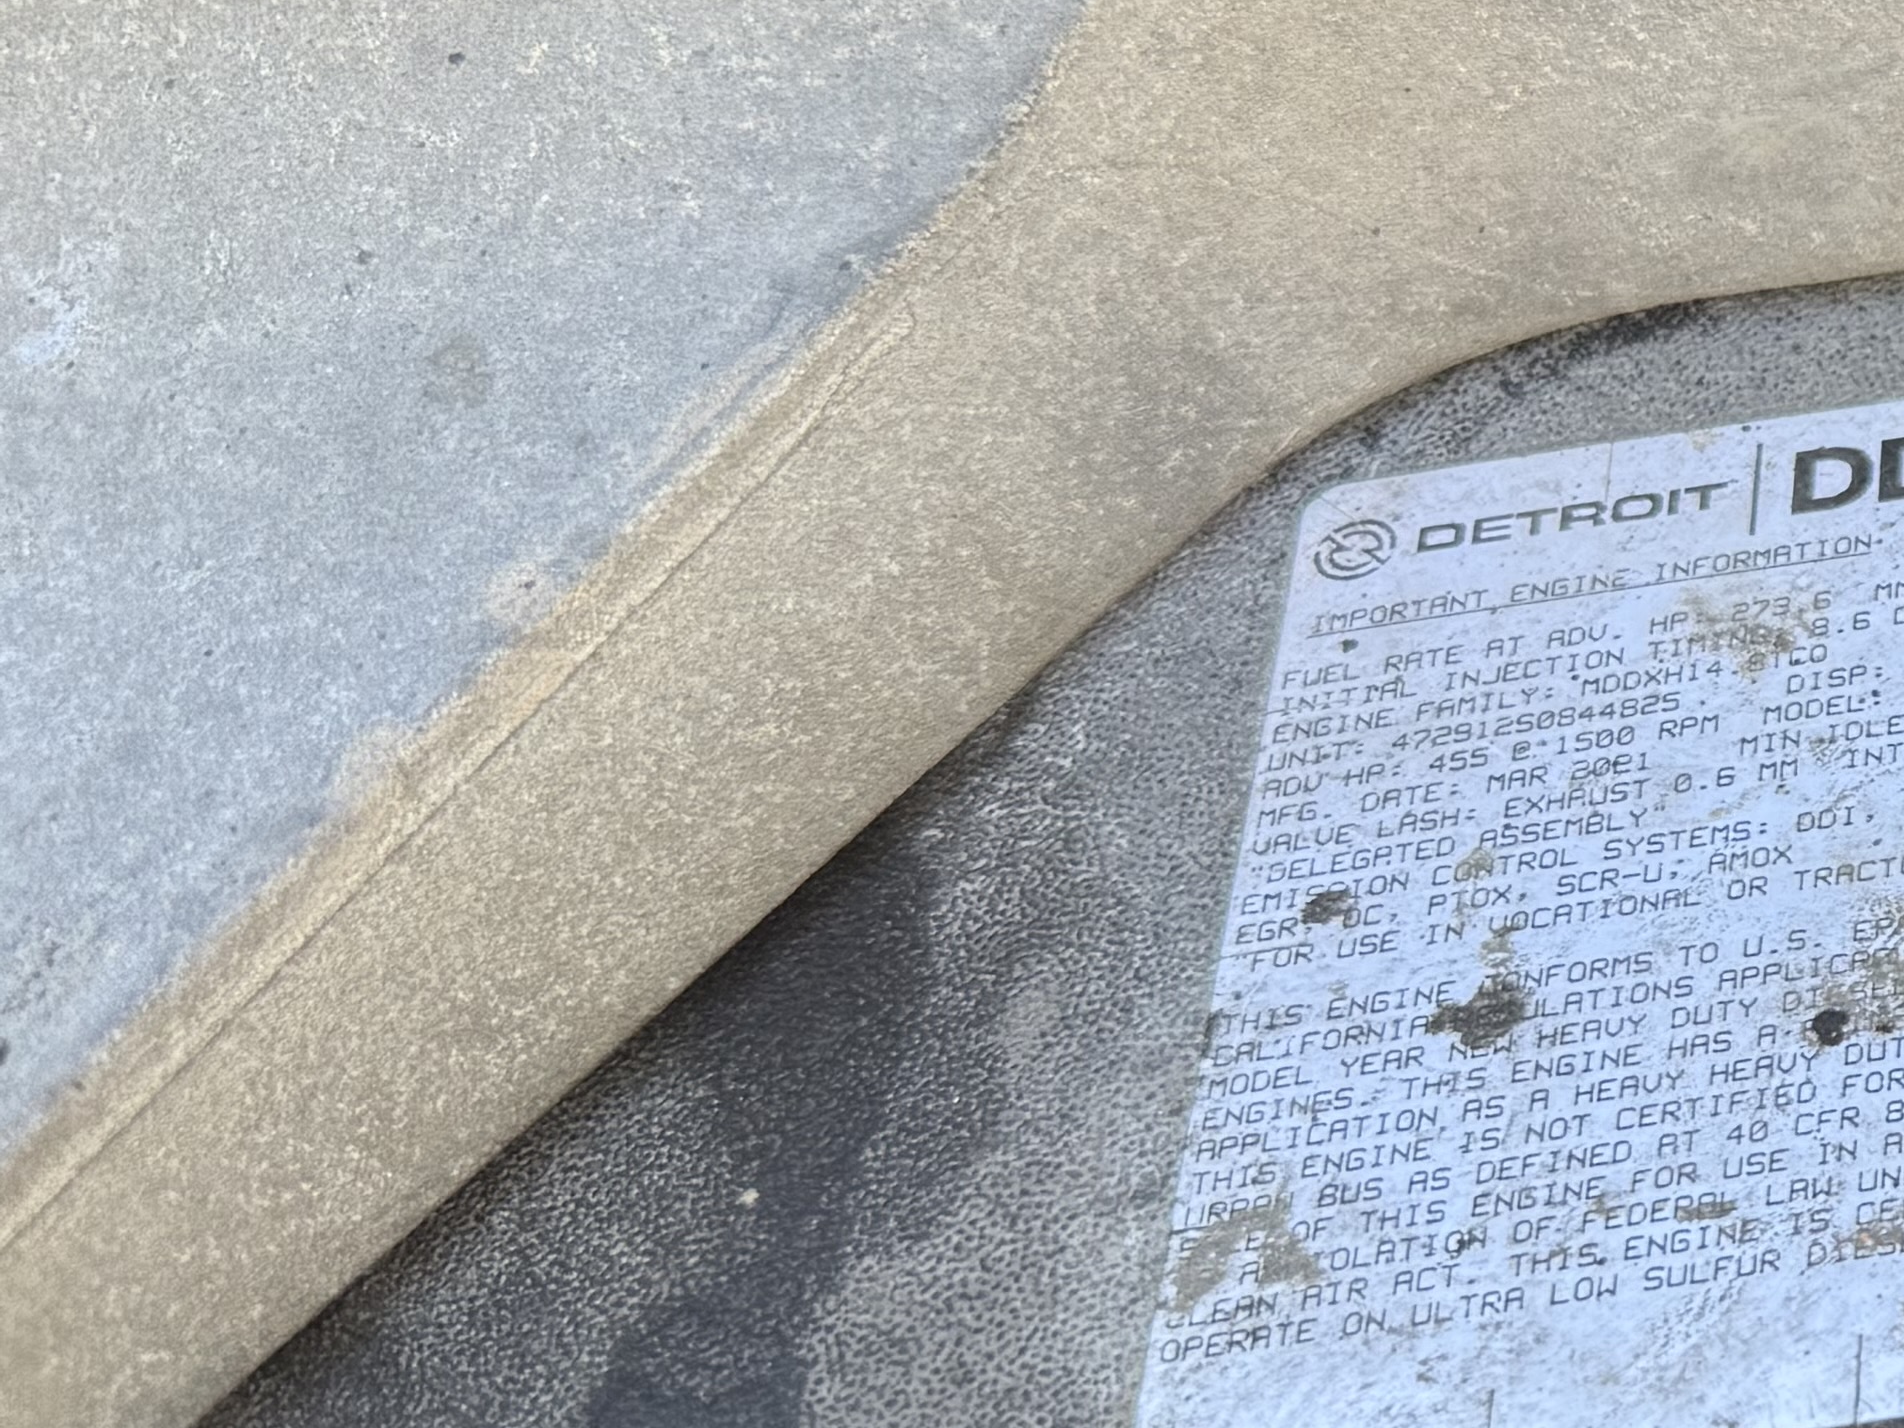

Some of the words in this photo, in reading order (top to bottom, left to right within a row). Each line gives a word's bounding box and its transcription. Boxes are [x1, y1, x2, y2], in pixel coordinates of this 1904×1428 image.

[1415, 480, 1734, 554] DETROIT
[1313, 588, 1493, 634] IMPORTANT
[1512, 567, 1634, 604] ENGINE
[1656, 532, 1875, 583] INFORMATION
[1278, 675, 1421, 715] INITIAL
[1443, 645, 1626, 691] INJECTION
[1811, 609, 1872, 638] 8.6
[1279, 659, 1363, 690] FUEL
[1382, 644, 1466, 675] RATE
[1485, 635, 1527, 660] AT
[1546, 620, 1624, 651] ADV.
[1260, 770, 1325, 799] ADV
[1344, 758, 1404, 787] HP:
[1428, 746, 1492, 775] 455
[1557, 724, 1638, 756] 1500
[1658, 712, 1721, 741] RPM
[1762, 688, 1882, 726] MODEL:
[1266, 735, 1367, 770] UNIT:
[1786, 661, 1884, 695] DISP:
[1270, 706, 1396, 744] ENGINE
[1415, 682, 1556, 722] FAMILY:
[1250, 821, 1358, 857] VALVE
[1377, 803, 1479, 839] LASH:
[1504, 778, 1653, 820] EXHAUST
[1673, 765, 1737, 796] 0.6
[1758, 756, 1800, 783] MM
[1255, 796, 1336, 829] MFG.
[1360, 778, 1462, 813] DATE:
[1487, 765, 1551, 795] MAR
[1739, 728, 1803, 758] MIN
[1432, 845, 1583, 888] CONTROL
[1603, 817, 1769, 863] SYSTEMS:
[1707, 842, 1793, 876] AMOX
[1338, 929, 1404, 959] USE
[1428, 919, 1469, 946] IN
[1489, 884, 1706, 937] VOCATIONAL
[1727, 874, 1771, 902] OR
[1217, 1001, 1307, 1037] THIS
[1327, 978, 1460, 1021] ENGINE
[1677, 940, 1721, 969] TO
[1743, 925, 1825, 960] U.S.
[1206, 1061, 1319, 1100] MODEL
[1339, 1044, 1429, 1081] YEAR
[1538, 1012, 1650, 1051] HEAVY
[1671, 996, 1760, 1031] DUTY
[1211, 1012, 1433, 1068] CALIFORNIA
[1401, 1066, 1491, 1103] THIS
[1512, 1043, 1646, 1086] ENGINE
[1668, 1030, 1735, 1063] HAS
[1188, 1159, 1281, 1195] THIS
[1301, 1135, 1438, 1179] ENGINE
[1462, 1125, 1505, 1155] IS
[1527, 1112, 1595, 1145] NOT
[1617, 1079, 1819, 1132] CERTIFIED
[1194, 1103, 1442, 1163] APPLICATION
[1463, 1093, 1509, 1123] AS
[1575, 1067, 1687, 1107] HEAVY
[1709, 1047, 1821, 1087] HEAVY
[1318, 1173, 1388, 1208] BUS
[1409, 1163, 1456, 1195] AS
[1477, 1137, 1637, 1185] DEFINED
[1658, 1127, 1704, 1158] AT
[1726, 1117, 1772, 1148] 40
[1794, 1104, 1862, 1138] CFR
[1290, 1213, 1338, 1245] OF
[1359, 1197, 1451, 1235] THIS
[1473, 1173, 1610, 1218] ENGINE
[1632, 1160, 1701, 1194] FOR
[1723, 1146, 1792, 1181] USE
[1818, 1136, 1859, 1167] IN
[1514, 1214, 1561, 1245] OF
[1583, 1187, 1743, 1235] FEDERAL
[1766, 1173, 1834, 1208] LAW
[1157, 1315, 1321, 1365] OPERATE
[1343, 1305, 1391, 1337] ON
[1412, 1285, 1529, 1327] ULTRA
[1551, 1271, 1622, 1306] LOW
[1644, 1247, 1783, 1293] SULFUR
[1302, 1275, 1373, 1310] AIR
[1394, 1259, 1483, 1296] ACT.
[1510, 1241, 1603, 1279] THIS
[1625, 1217, 1763, 1262] ENGINE
[1789, 1207, 1832, 1238] IS
